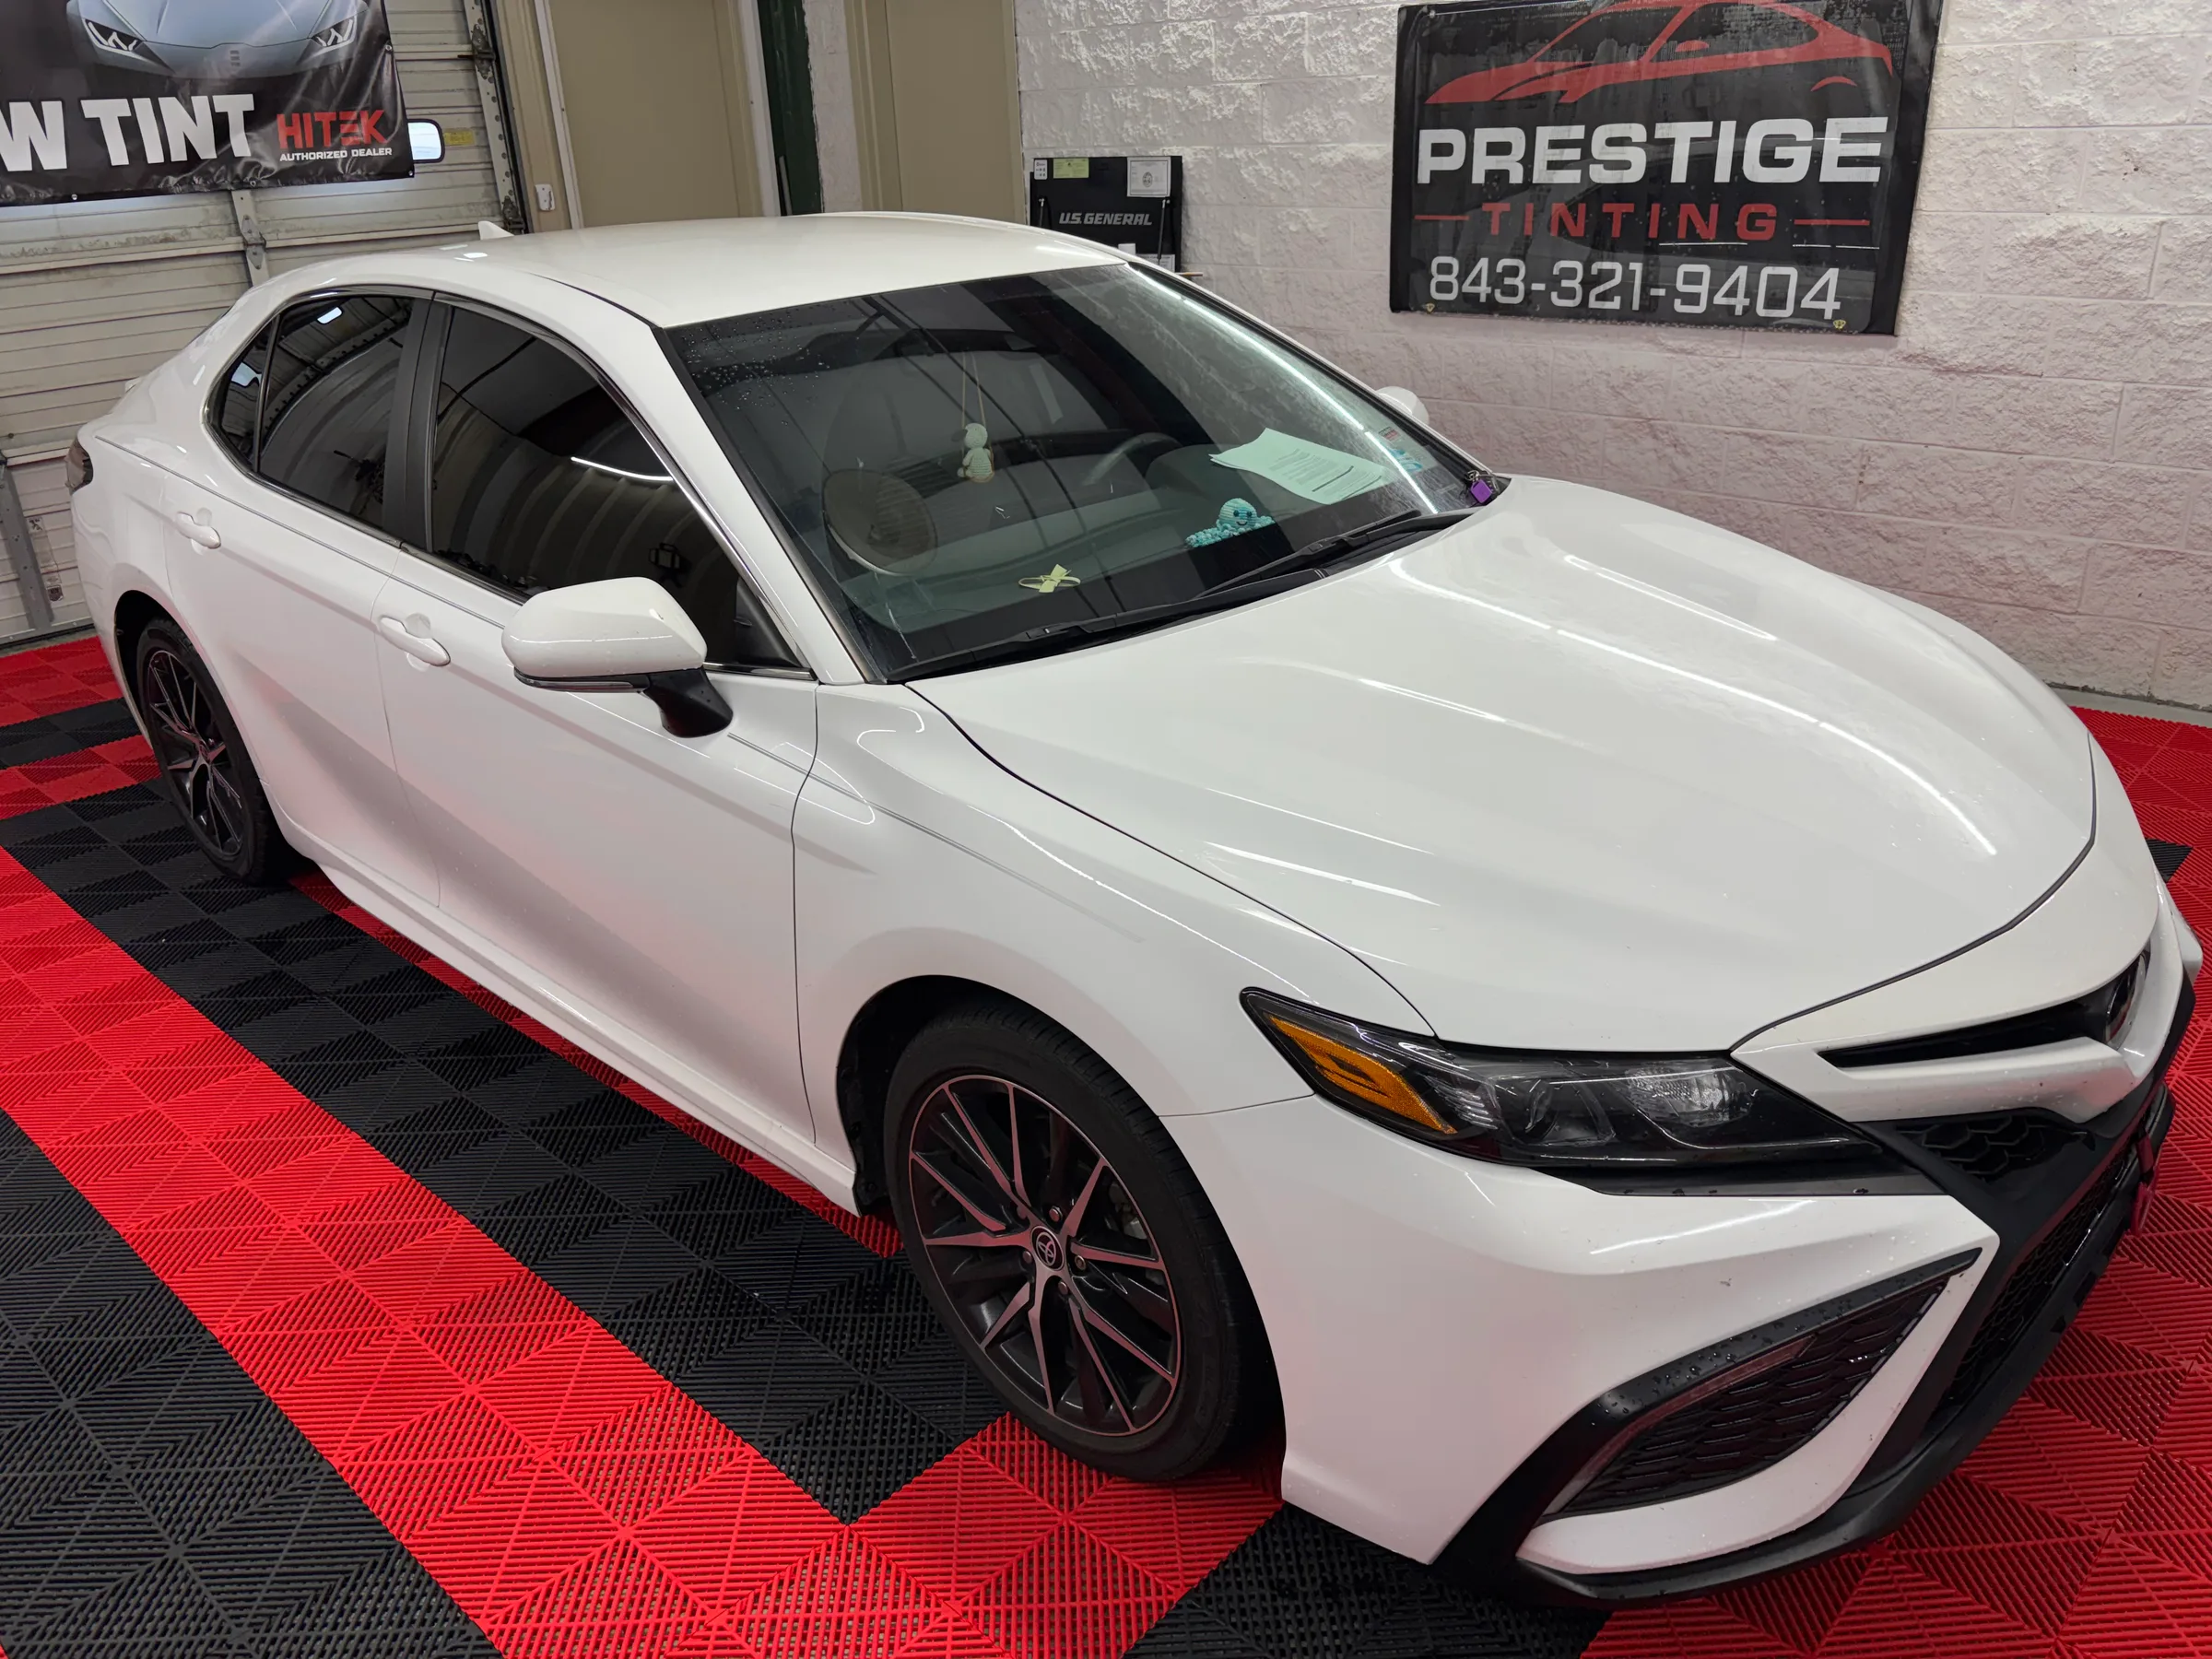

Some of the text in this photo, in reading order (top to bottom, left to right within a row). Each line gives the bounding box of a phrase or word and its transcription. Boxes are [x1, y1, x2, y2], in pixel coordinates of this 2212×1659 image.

[80, 93, 255, 167] TINT
[276, 109, 388, 149] HITEK
[279, 147, 393, 162] AUTHORIZED DEALER
[1418, 116, 1889, 184] PRESTIGE
[1083, 212, 1153, 226] GENERAL
[1481, 202, 1778, 241] TINTING
[1430, 255, 1841, 320] 843-321-9404
